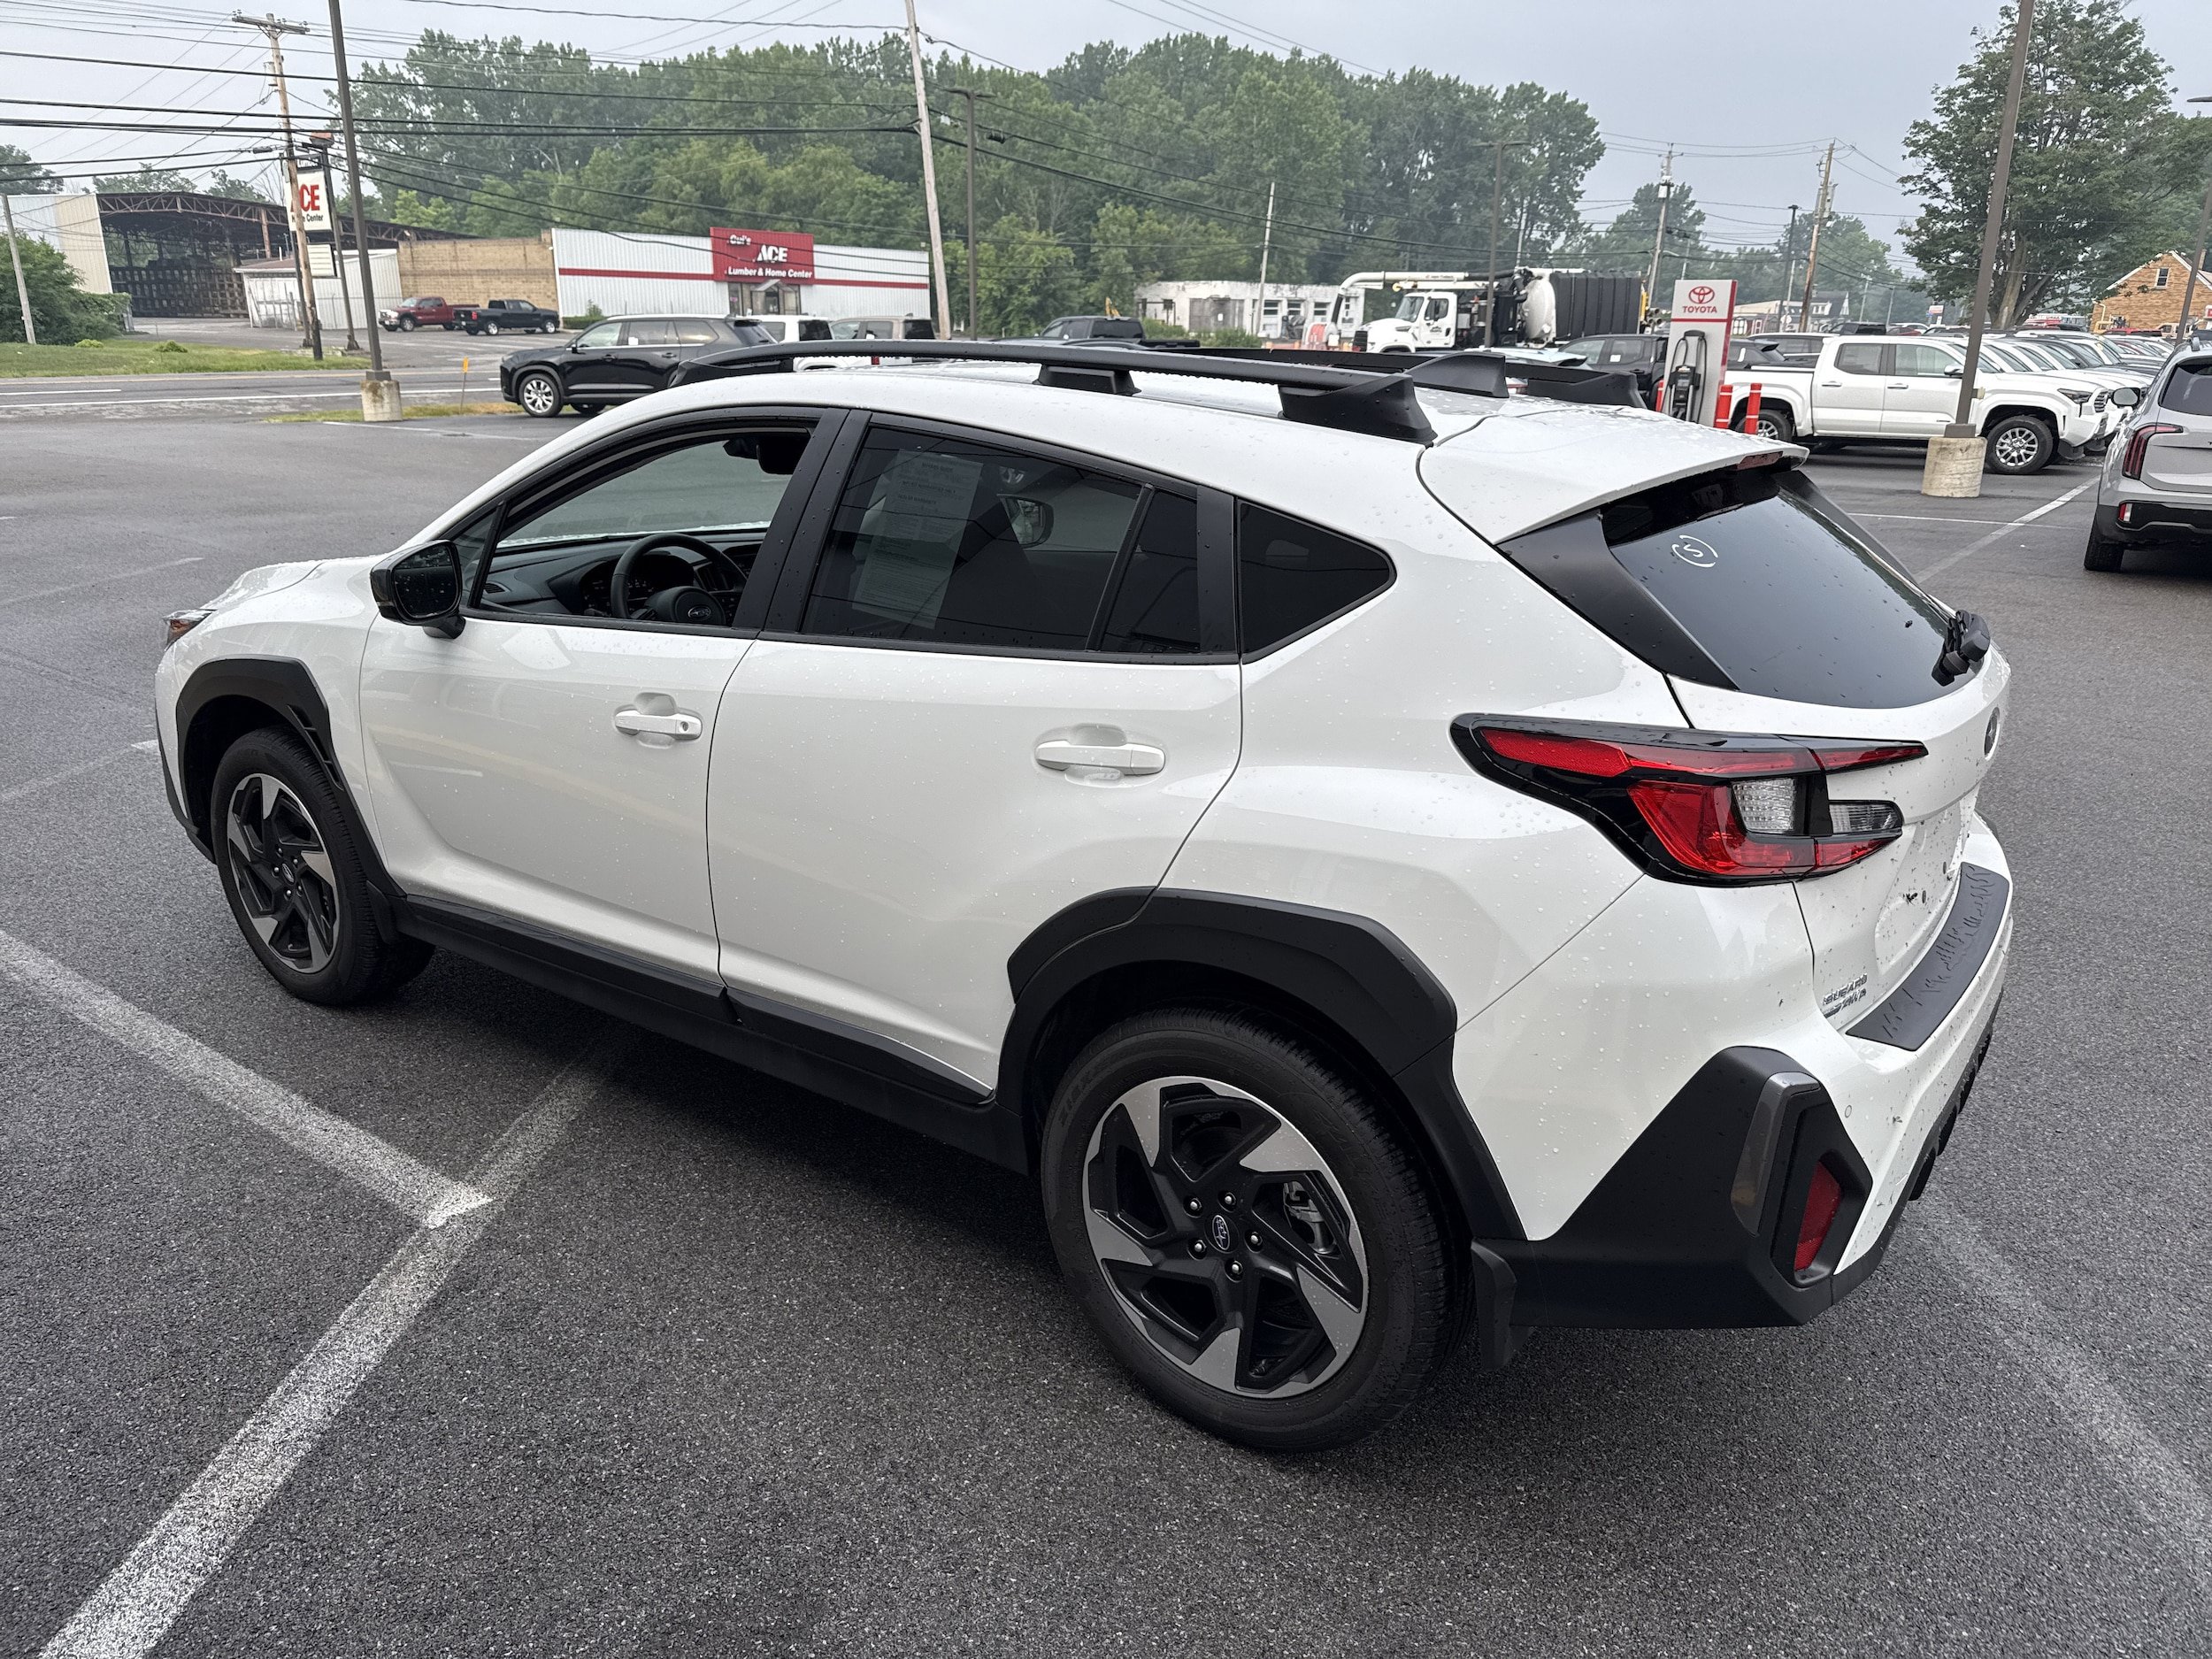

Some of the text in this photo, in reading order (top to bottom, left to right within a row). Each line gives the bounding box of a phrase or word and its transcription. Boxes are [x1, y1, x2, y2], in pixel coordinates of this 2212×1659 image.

[290, 184, 320, 212] CE
[306, 213, 324, 222] Center
[757, 244, 788, 264] ACE
[727, 265, 813, 279] Lumber & Home Center
[1682, 305, 1718, 314] TOYOTA
